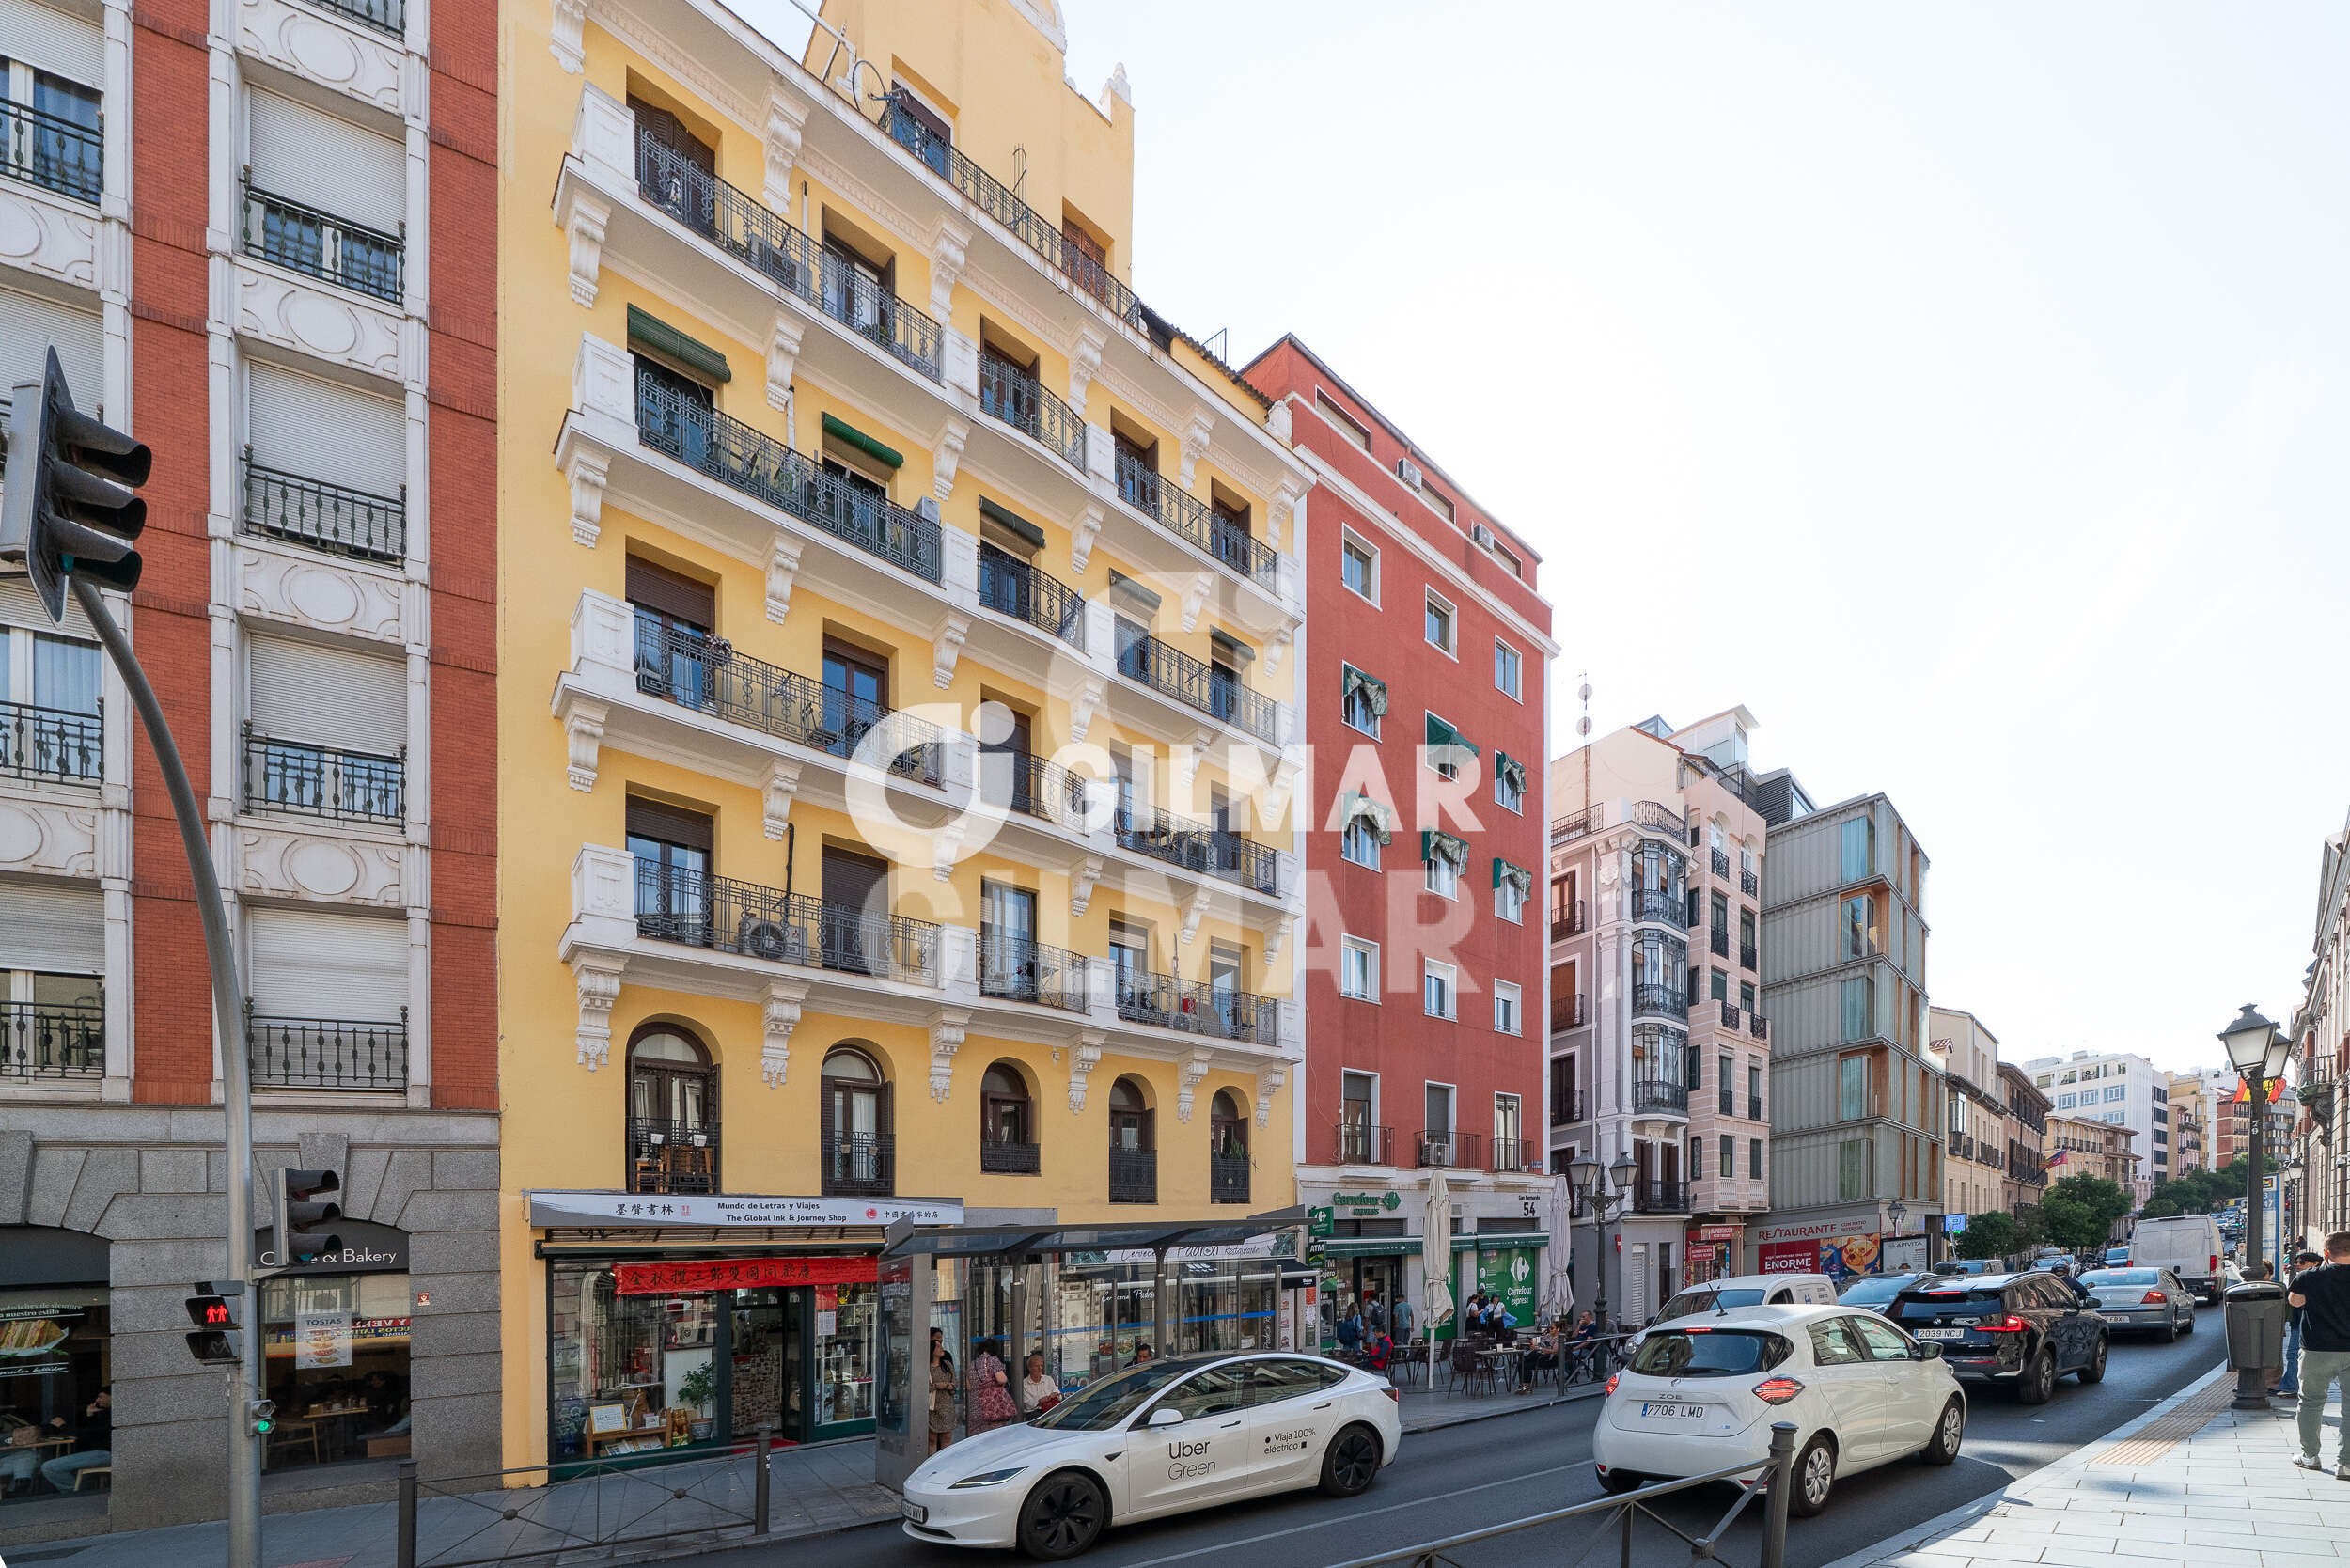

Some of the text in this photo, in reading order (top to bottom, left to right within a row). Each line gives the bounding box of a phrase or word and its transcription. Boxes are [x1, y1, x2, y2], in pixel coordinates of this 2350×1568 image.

[796, 1201, 821, 1211] Viajes
[1523, 1201, 1536, 1217] 54
[797, 1215, 826, 1223] Journey
[828, 1215, 847, 1223] Shop
[1758, 1223, 1837, 1241] RESTAURANTE
[1309, 1244, 1324, 1252] ATM
[343, 1247, 397, 1264] Bakery
[1764, 1257, 1812, 1270] ENORME
[1507, 1286, 1532, 1296] Carrefour
[1511, 1297, 1529, 1306] express
[306, 1318, 342, 1326] TOSTAS
[1919, 1329, 1942, 1338] 2039
[1647, 1404, 1704, 1419] 7706 LMD
[1274, 1427, 1316, 1443] Viaja 100%
[1168, 1440, 1211, 1460] Uber
[1263, 1440, 1299, 1455] eléctrico
[1167, 1460, 1216, 1481] Green
